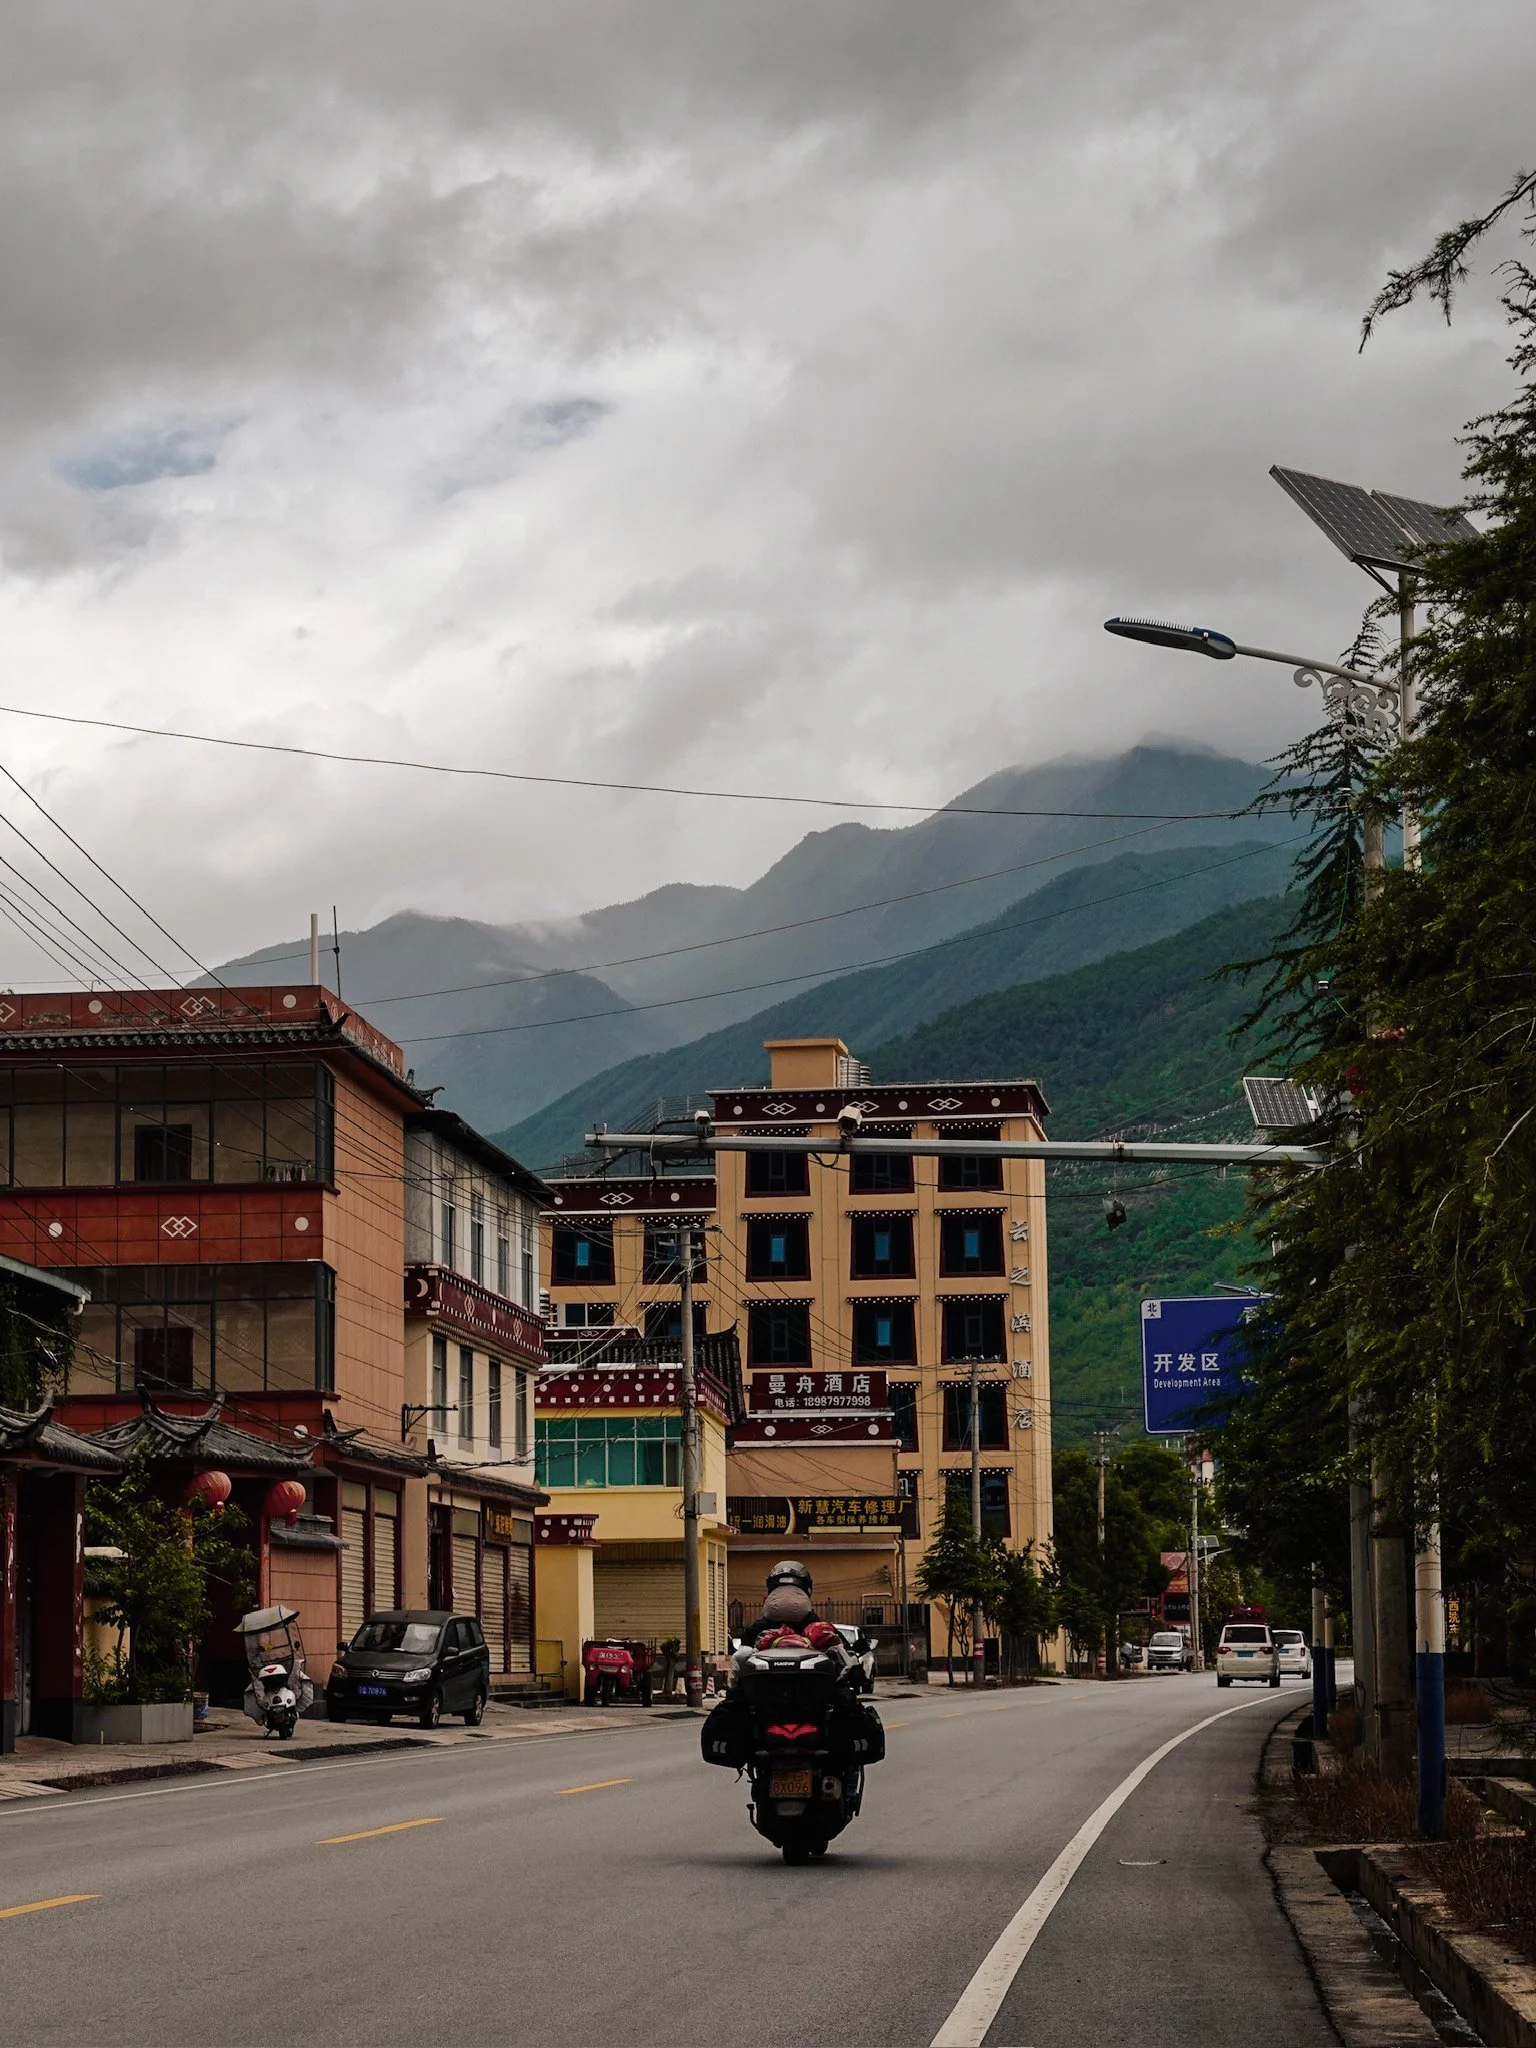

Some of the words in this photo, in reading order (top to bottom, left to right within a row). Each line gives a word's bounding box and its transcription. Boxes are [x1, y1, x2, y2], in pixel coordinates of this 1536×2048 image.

[1147, 1302, 1157, 1313] 北
[1009, 1221, 1034, 1430] 云之滨酒店
[1153, 1352, 1220, 1373] 开发区
[768, 1373, 871, 1395] 曼舟酒店
[1153, 1377, 1201, 1389] Development
[1203, 1376, 1221, 1387] Area
[797, 1498, 913, 1515] 新慧汽车修理厂
